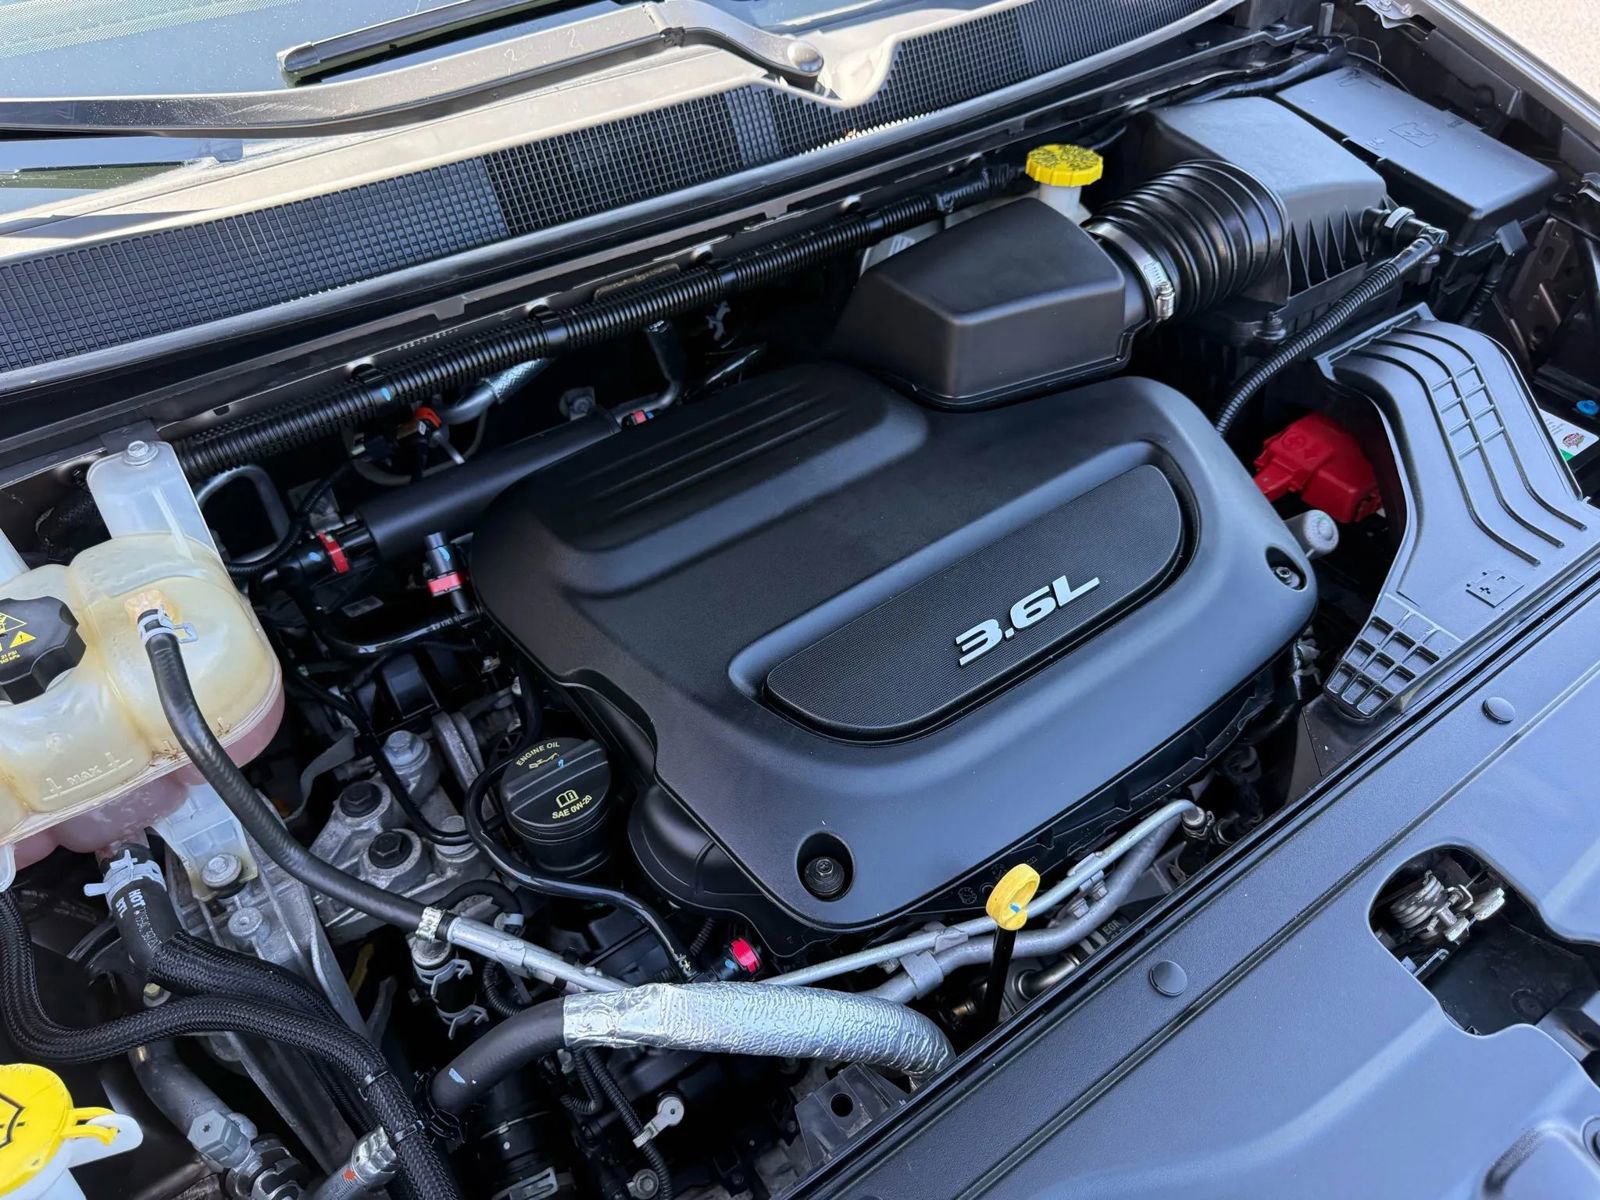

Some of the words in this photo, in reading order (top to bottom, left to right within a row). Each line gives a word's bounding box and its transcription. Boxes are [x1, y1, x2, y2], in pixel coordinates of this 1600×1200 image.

[955, 575, 1100, 666] 3.6L
[516, 745, 545, 766] ENGINE
[552, 807, 571, 819] SAE
[570, 795, 593, 812] 0W-20
[128, 888, 146, 908] HOT
